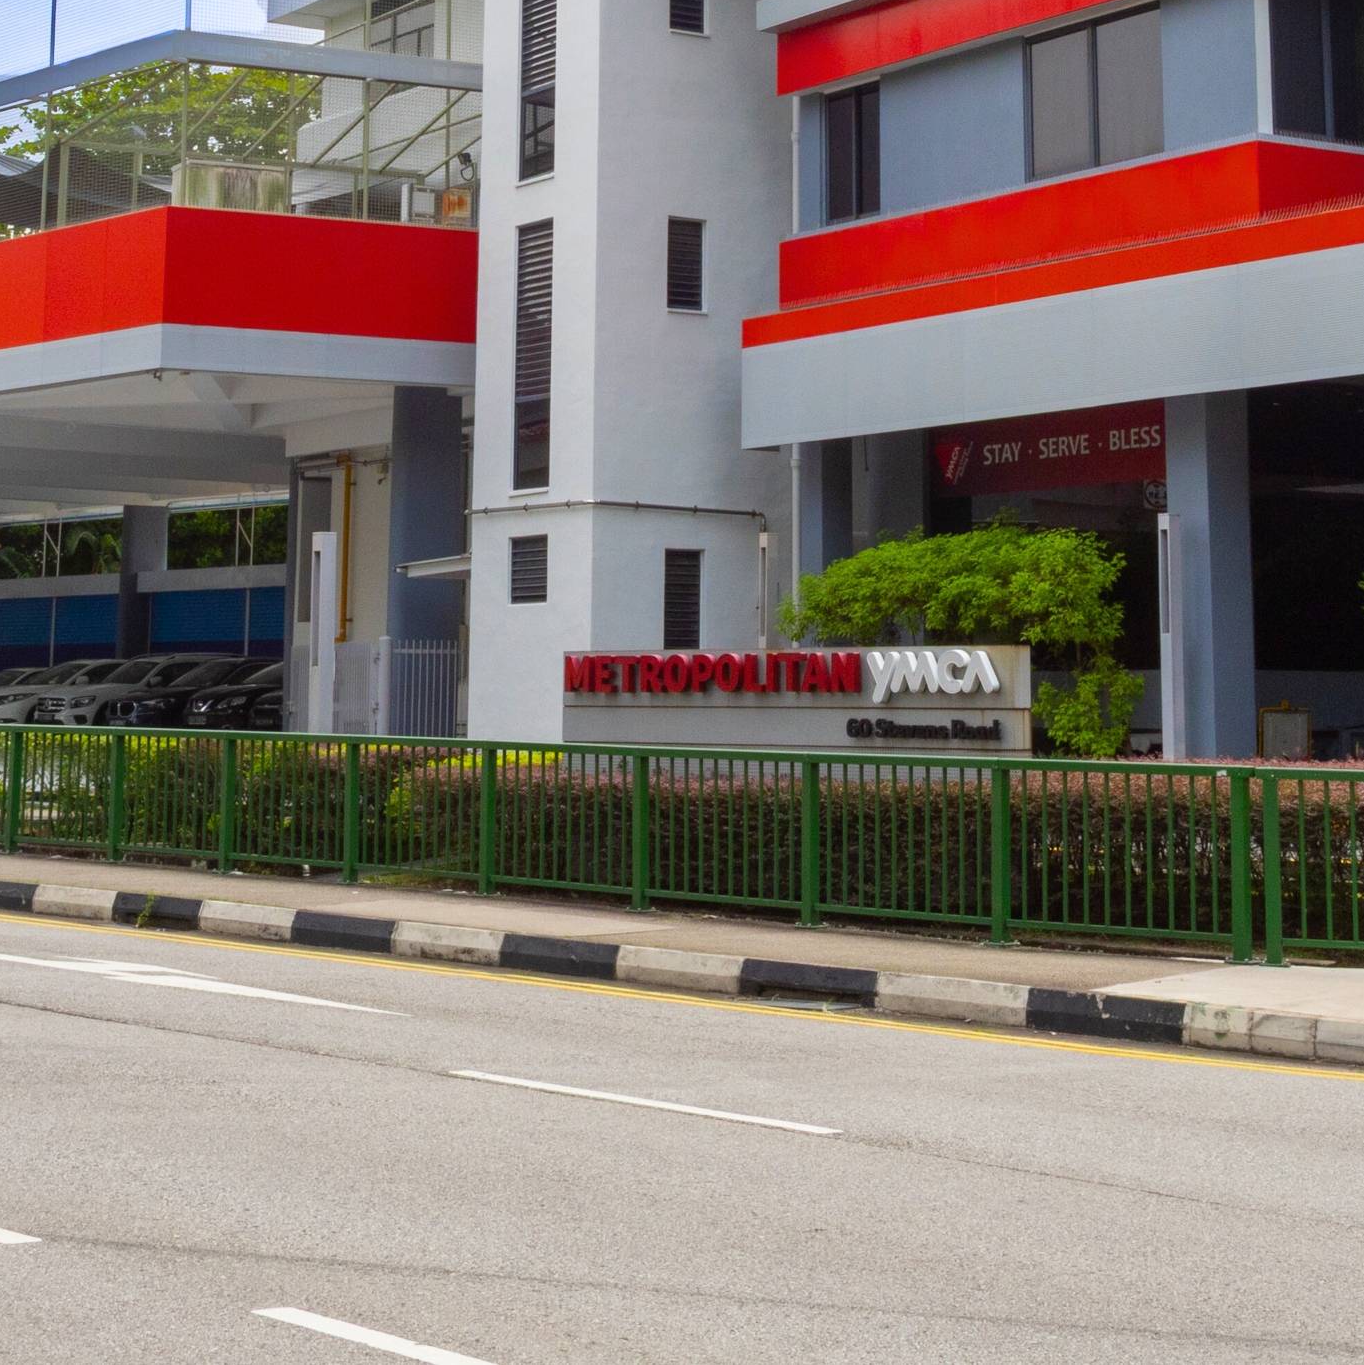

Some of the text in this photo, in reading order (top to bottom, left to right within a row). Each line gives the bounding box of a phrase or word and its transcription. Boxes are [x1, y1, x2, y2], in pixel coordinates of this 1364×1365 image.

[983, 442, 1023, 465] STAY
[1039, 434, 1091, 460] SERVE
[1109, 425, 1162, 451] BLESS
[564, 652, 863, 693] METROPOLITAN
[846, 718, 873, 738] 60
[951, 719, 1002, 740] Road
